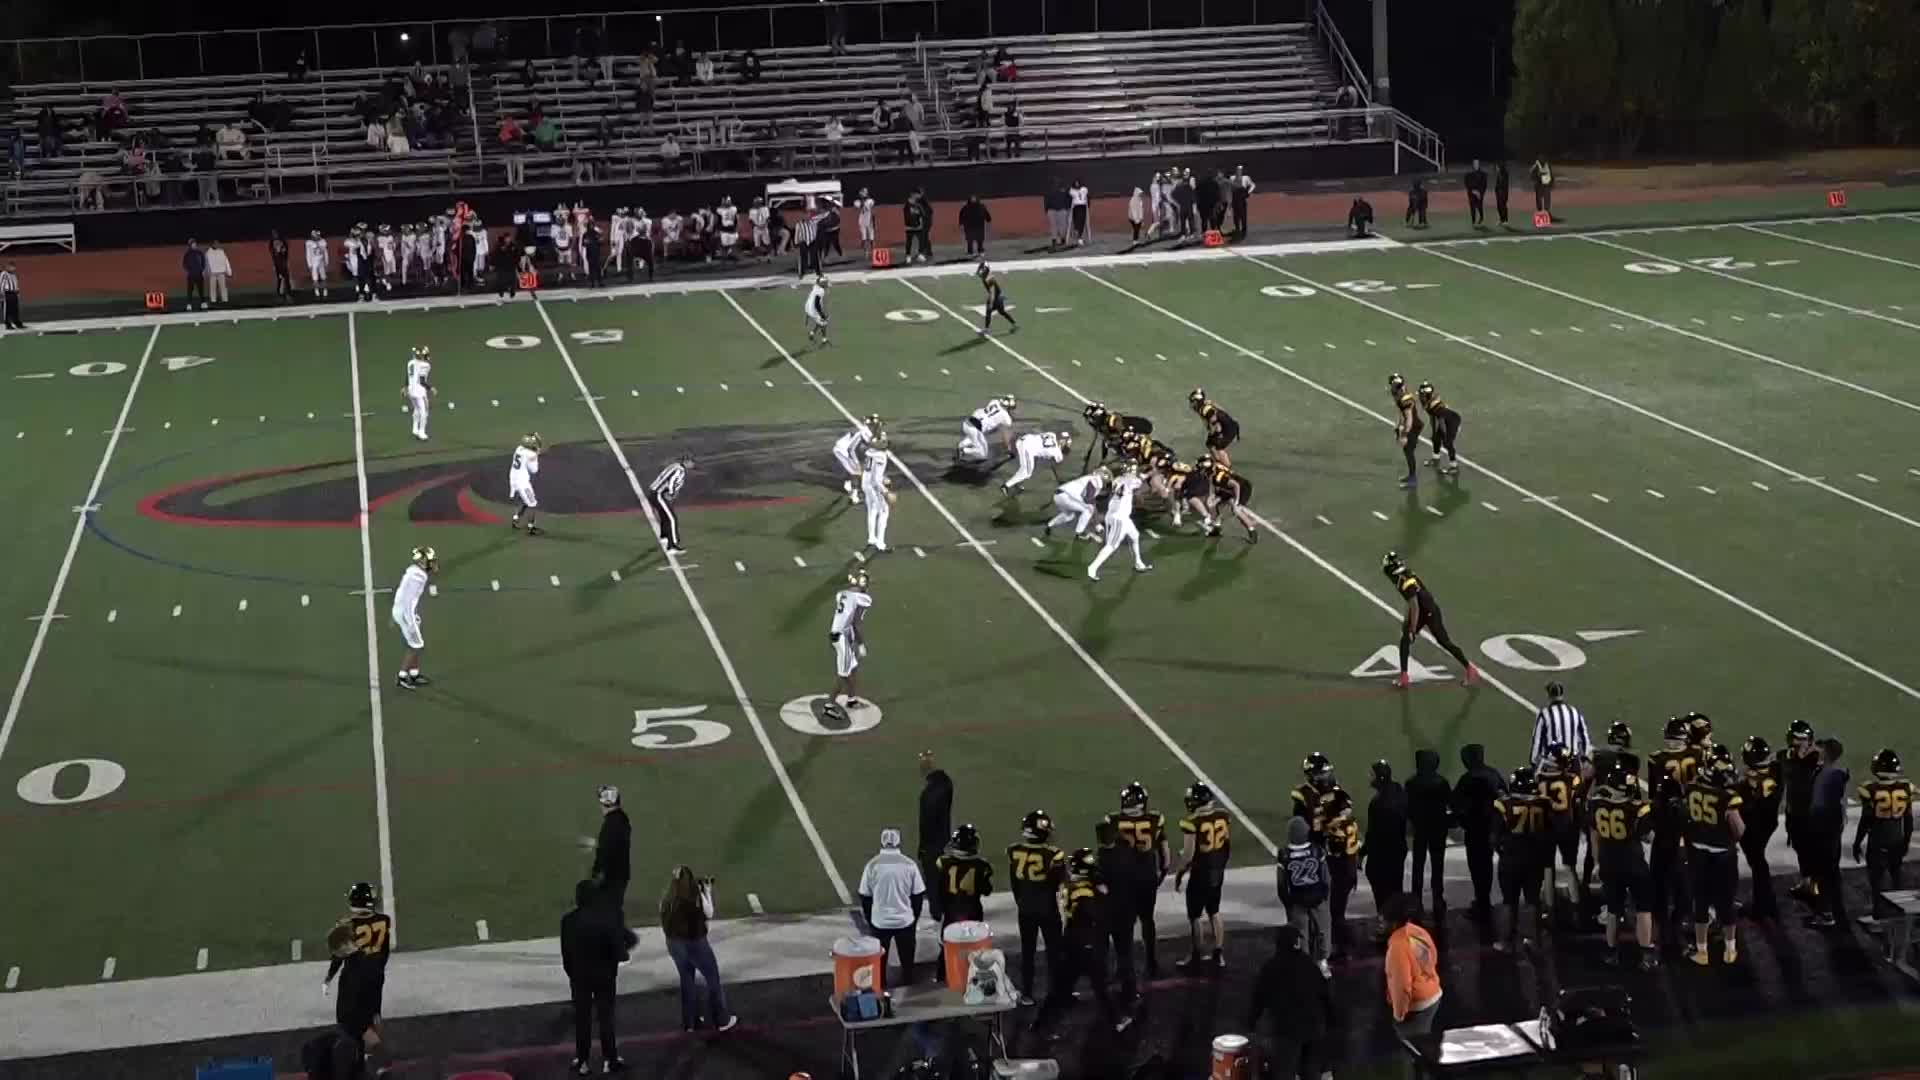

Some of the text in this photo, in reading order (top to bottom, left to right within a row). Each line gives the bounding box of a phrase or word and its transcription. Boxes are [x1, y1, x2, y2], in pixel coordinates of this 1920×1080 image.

[1688, 790, 1719, 825] 65
[1874, 789, 1907, 818] 26
[1200, 818, 1230, 852] 32
[1594, 806, 1627, 840] 66
[947, 864, 977, 894] 14
[1012, 850, 1047, 881] 72
[1287, 857, 1320, 886] 22
[354, 920, 387, 954] 27
